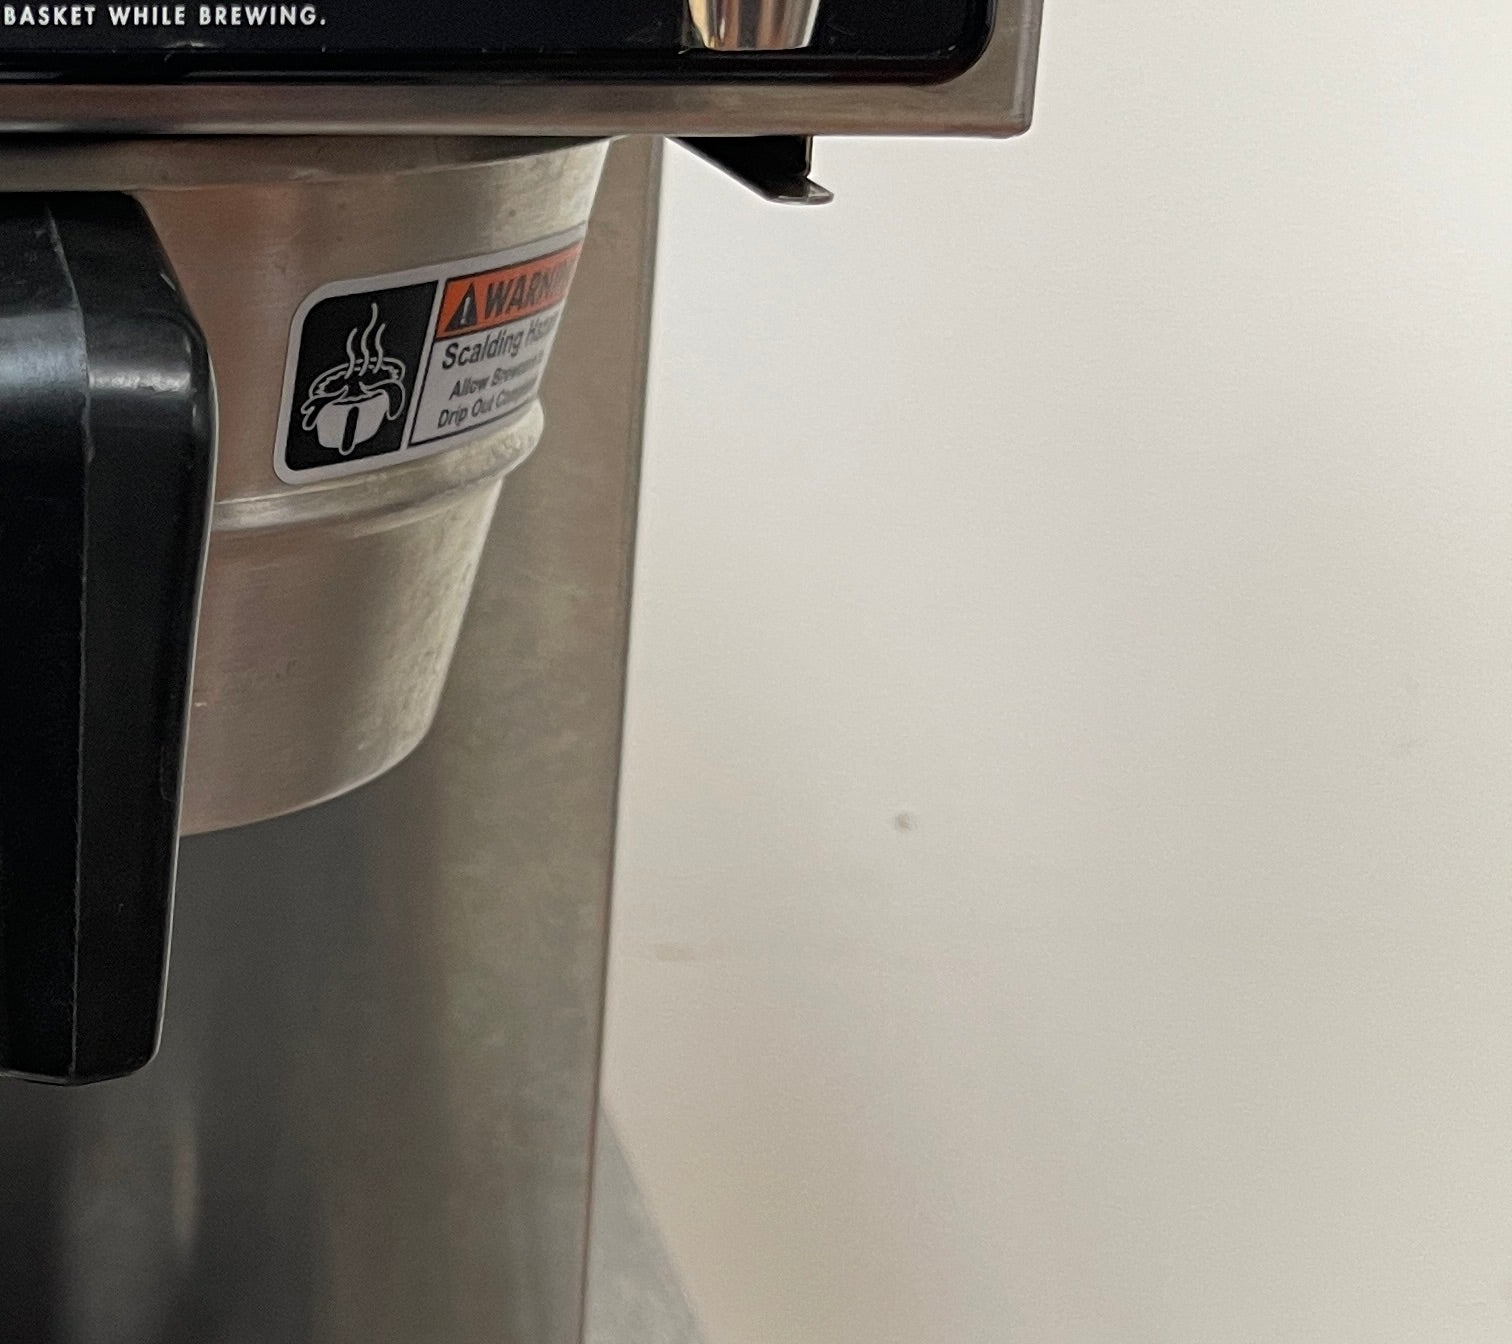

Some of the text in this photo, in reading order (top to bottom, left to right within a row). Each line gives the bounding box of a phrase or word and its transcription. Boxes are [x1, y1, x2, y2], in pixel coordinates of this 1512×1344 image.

[4, 4, 96, 27] BASKET
[108, 4, 186, 27] WHILE
[199, 4, 326, 27] BREWING.
[442, 331, 523, 369] Scalding
